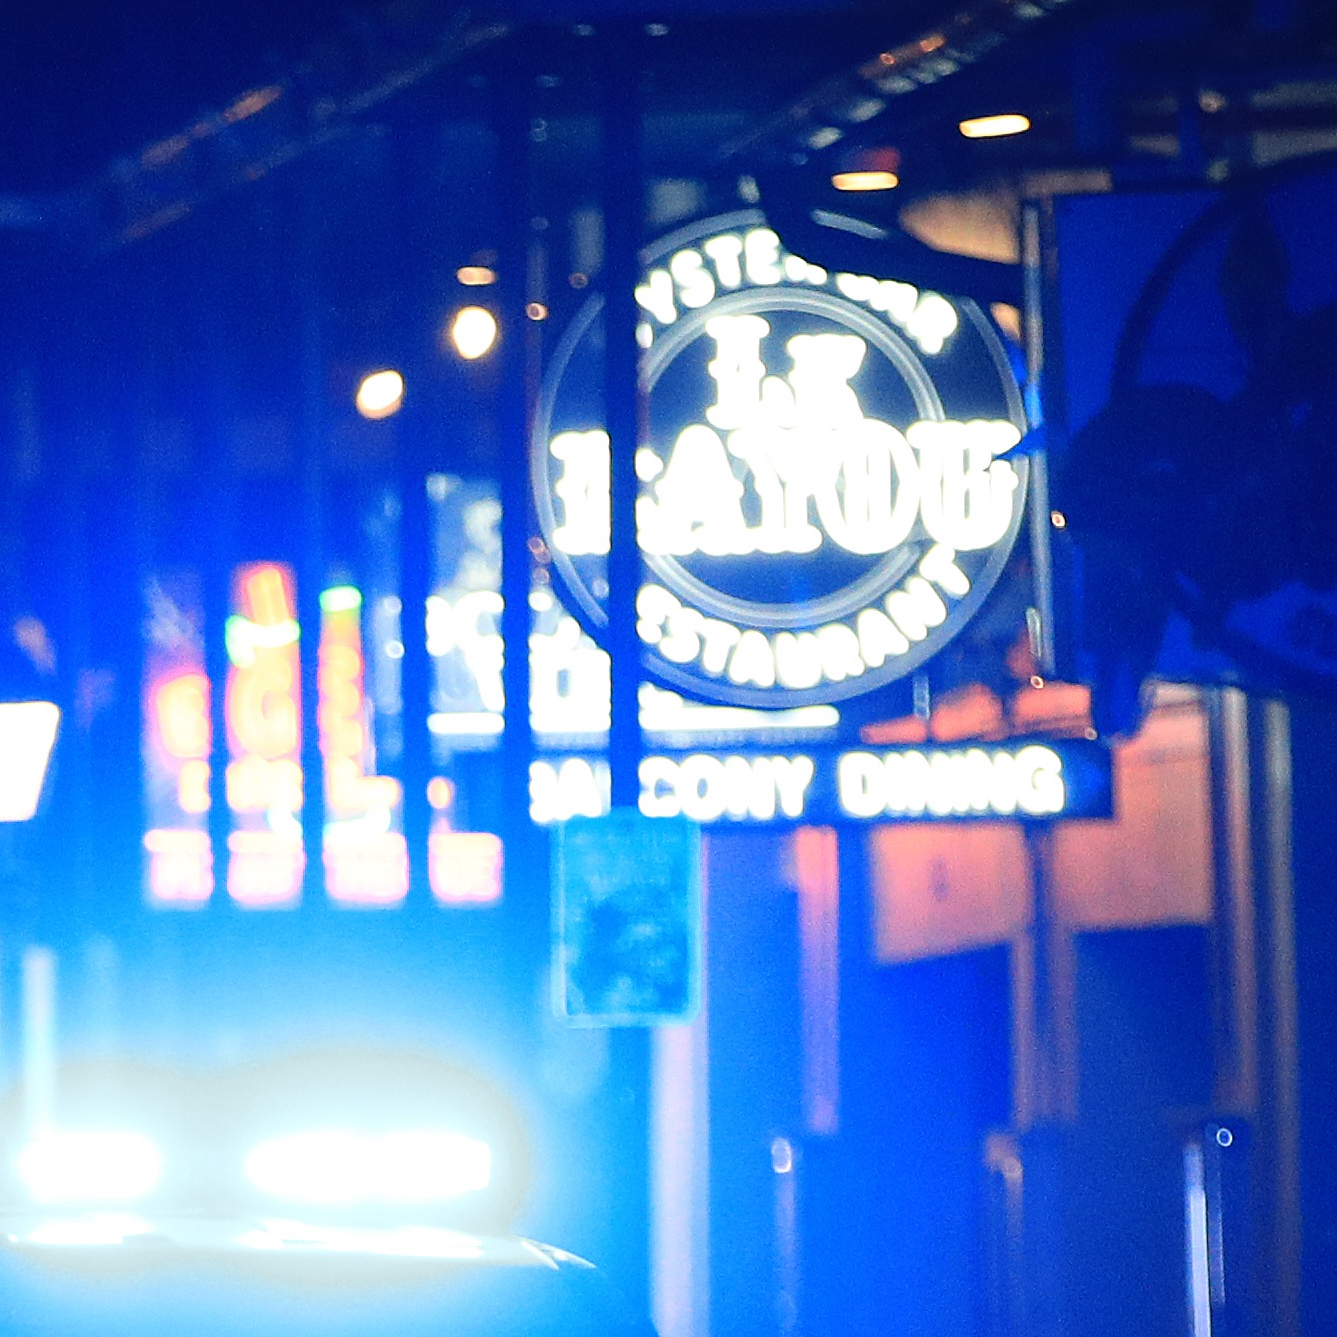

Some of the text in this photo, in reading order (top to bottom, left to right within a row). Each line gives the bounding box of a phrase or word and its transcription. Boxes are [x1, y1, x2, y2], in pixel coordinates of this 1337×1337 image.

[635, 228, 828, 347] YSTE
[704, 314, 868, 428] LE
[550, 418, 1022, 556] BAYOU
[636, 546, 971, 690] ESTAURANT
[837, 745, 1065, 818] DINING
